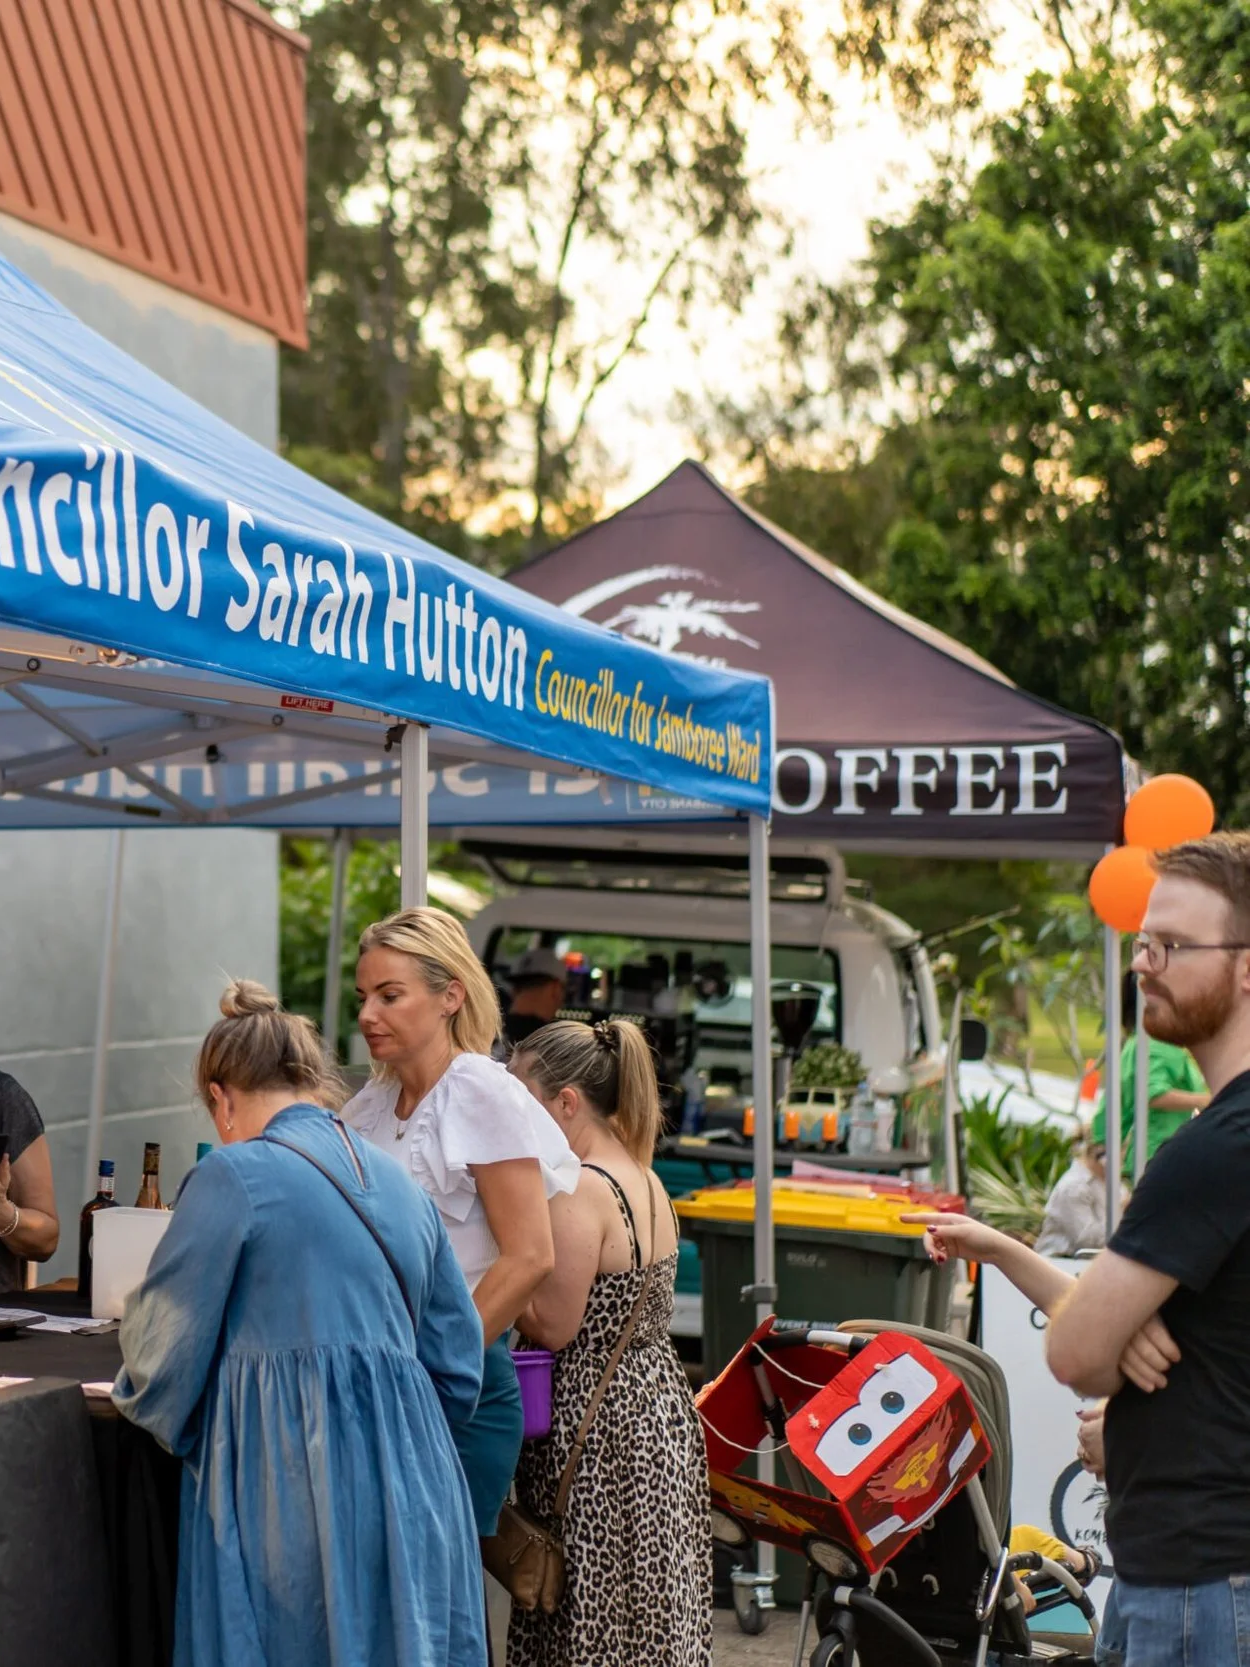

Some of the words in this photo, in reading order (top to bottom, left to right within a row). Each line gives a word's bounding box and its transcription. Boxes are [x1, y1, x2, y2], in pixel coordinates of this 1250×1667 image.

[225, 499, 373, 665] Sarah
[381, 551, 528, 711] Hutton
[286, 696, 303, 705] LIFT
[306, 698, 329, 709] HERE
[535, 649, 630, 739] Councillor
[629, 680, 655, 747] for
[655, 694, 726, 773] Jamboree
[726, 721, 760, 784] Ward
[770, 743, 1068, 816] OFFEE
